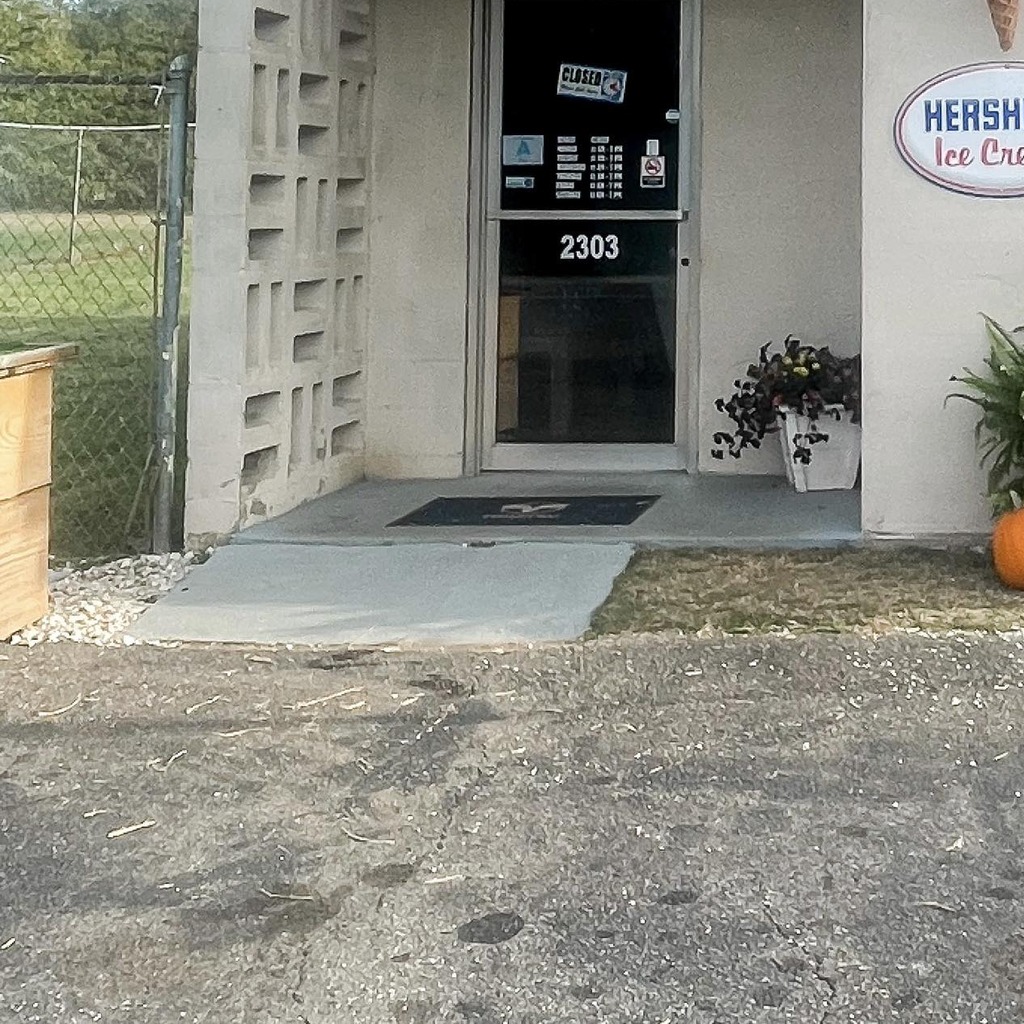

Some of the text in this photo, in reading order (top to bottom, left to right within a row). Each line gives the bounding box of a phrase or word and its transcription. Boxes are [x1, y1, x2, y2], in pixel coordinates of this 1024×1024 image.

[562, 67, 602, 86] CLOSED
[934, 137, 974, 166] Ice
[560, 234, 619, 260] 2303
